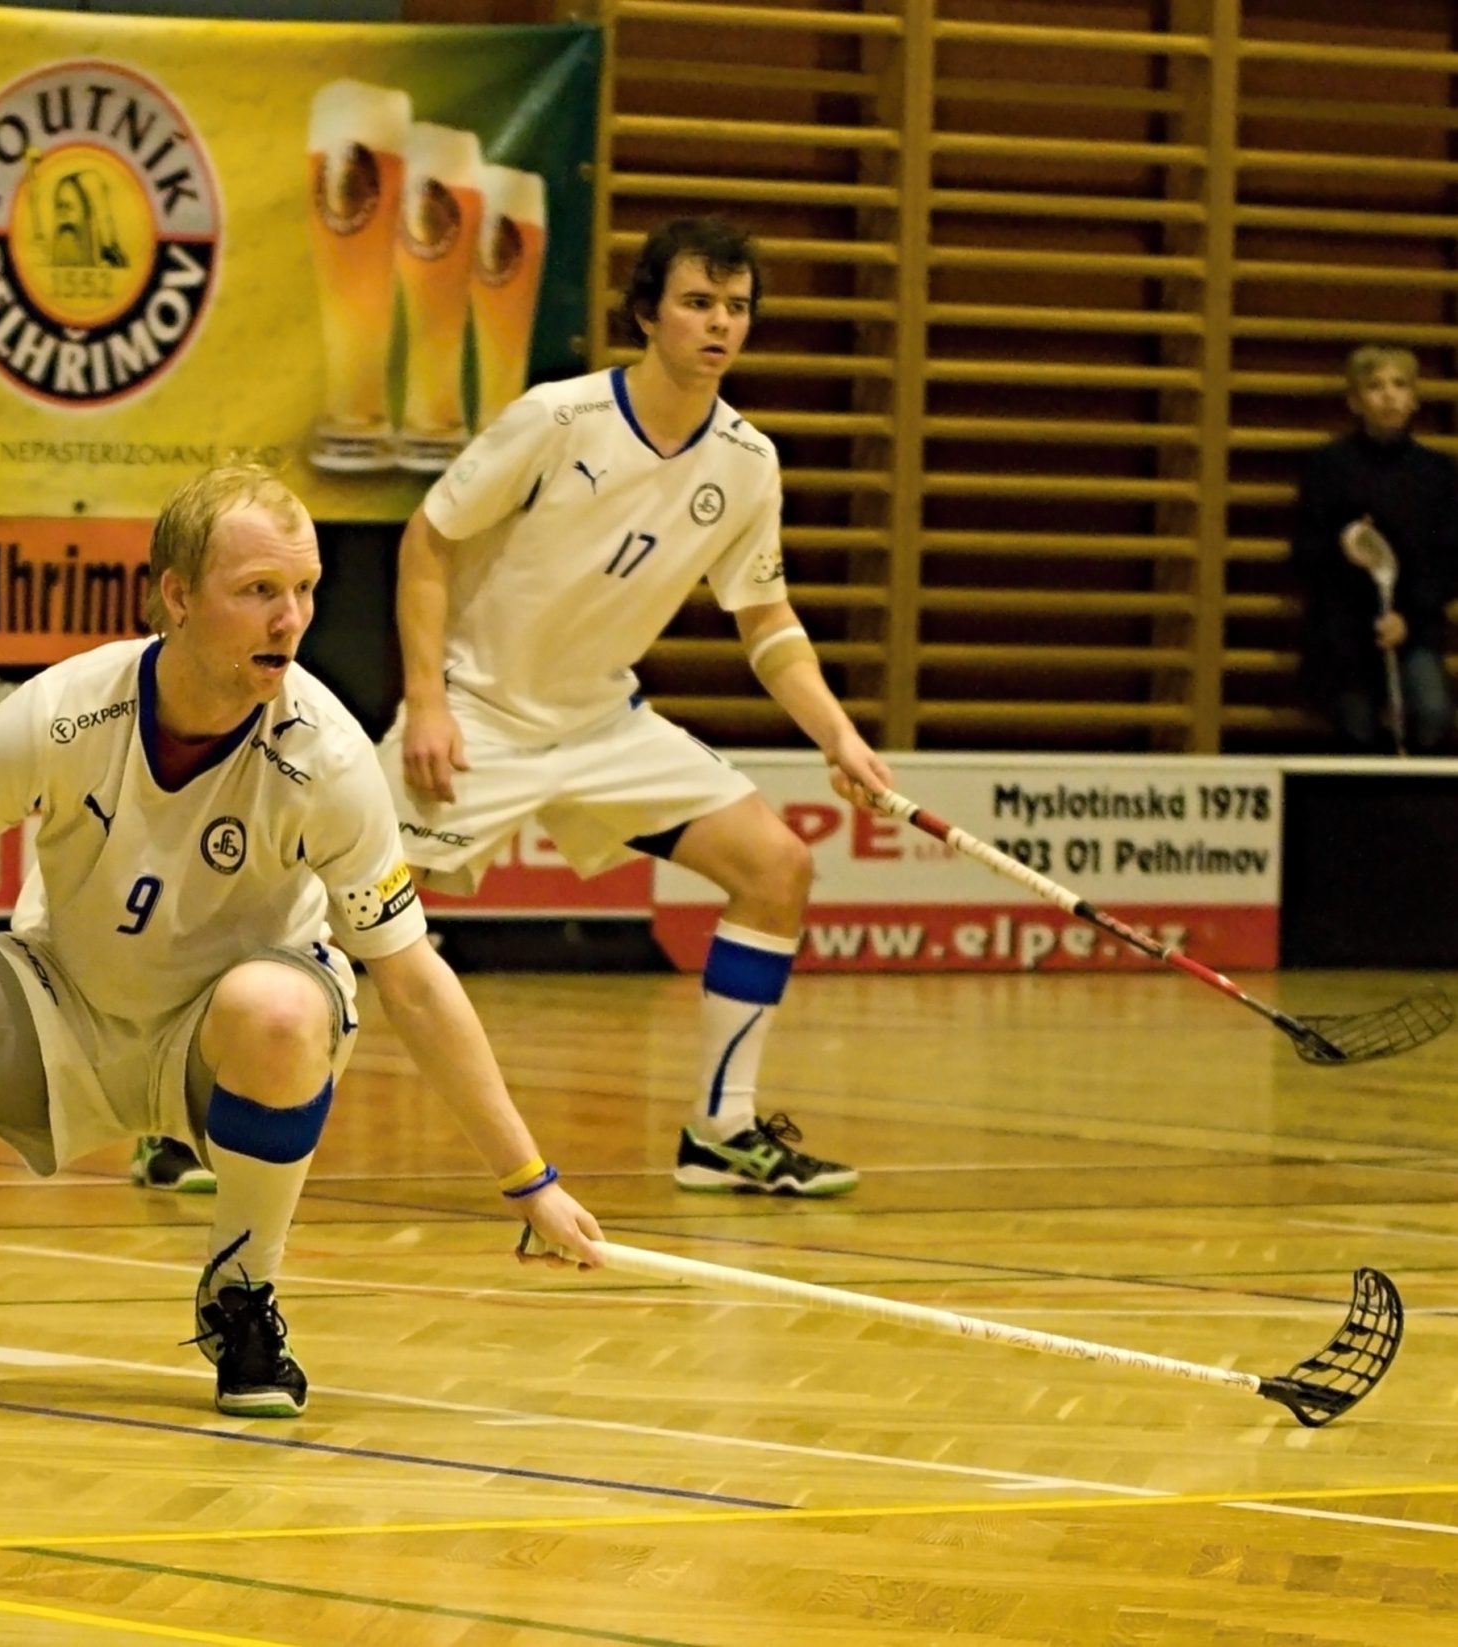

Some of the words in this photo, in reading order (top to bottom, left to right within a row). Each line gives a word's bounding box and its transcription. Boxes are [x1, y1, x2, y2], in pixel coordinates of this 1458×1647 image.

[604, 531, 657, 579] 17
[1198, 784, 1271, 822] 1978
[1065, 838, 1101, 874] 01
[116, 874, 165, 936] 9
